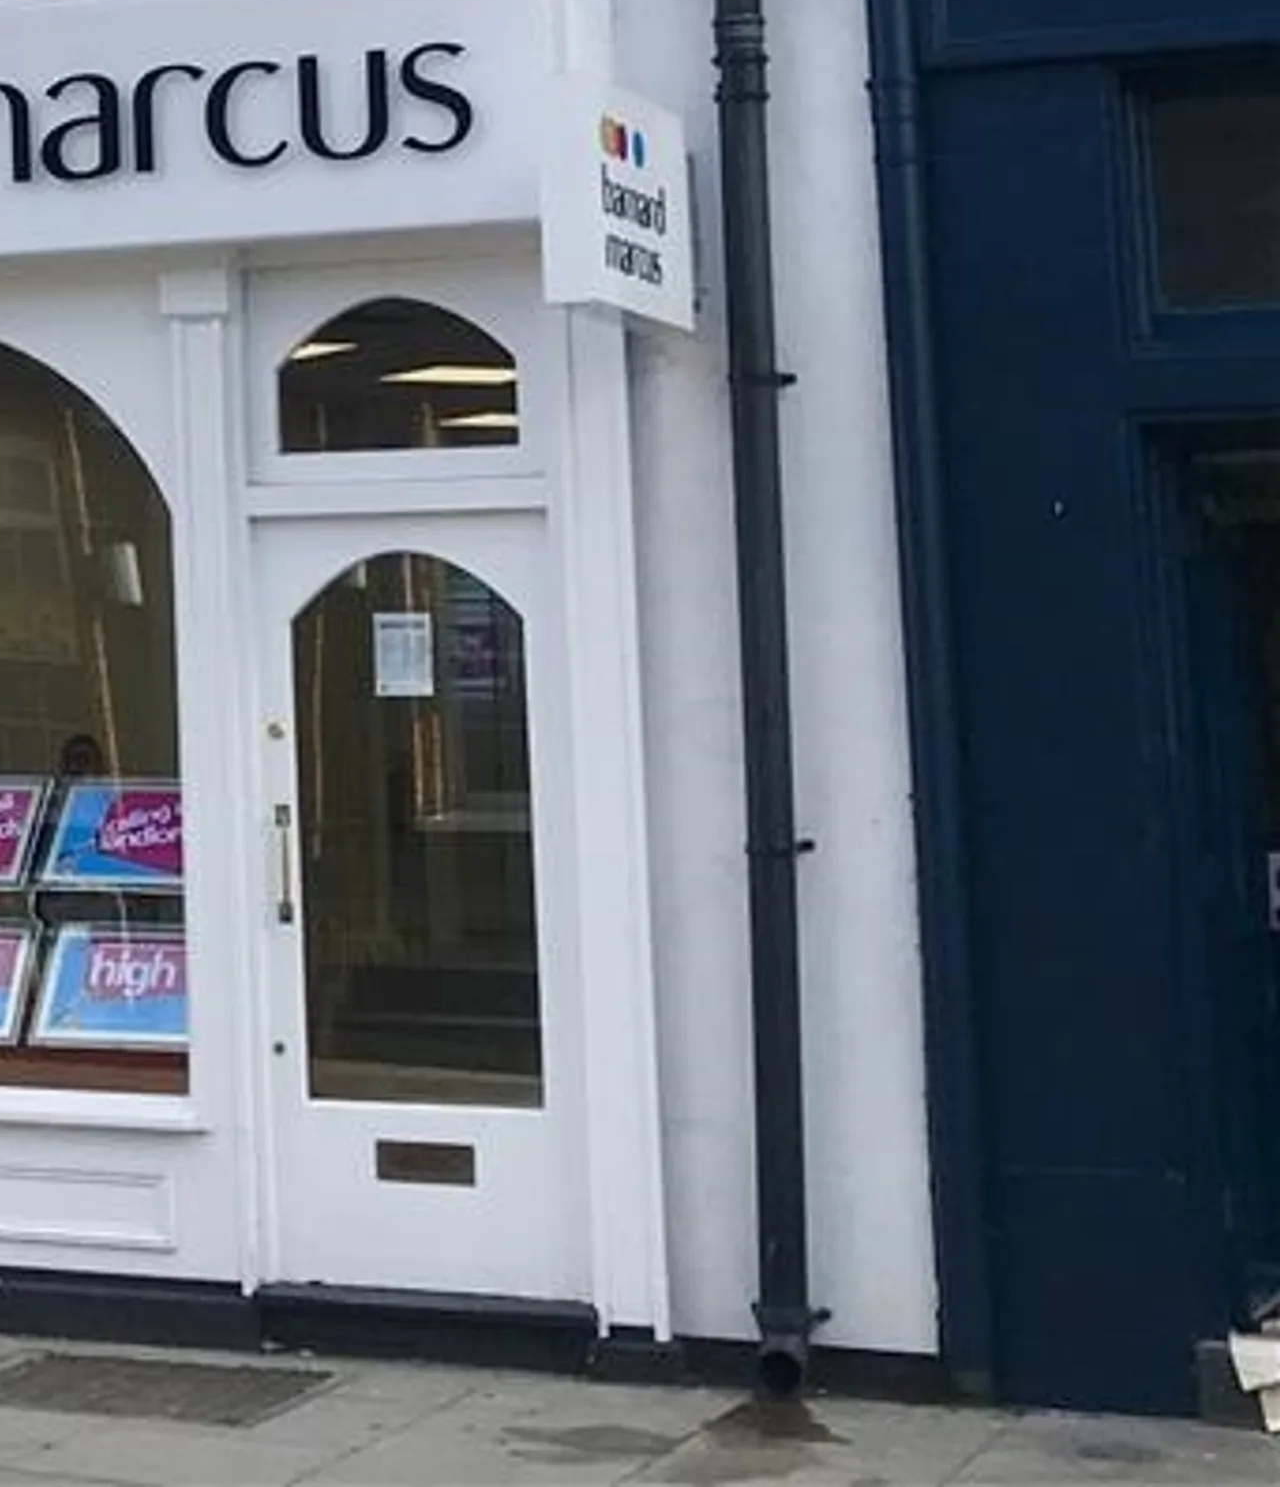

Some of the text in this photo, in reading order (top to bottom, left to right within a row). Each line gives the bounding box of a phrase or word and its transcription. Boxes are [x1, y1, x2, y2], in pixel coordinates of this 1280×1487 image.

[601, 161, 667, 237] barnard
[604, 232, 663, 286] marcus
[90, 945, 177, 998] high
